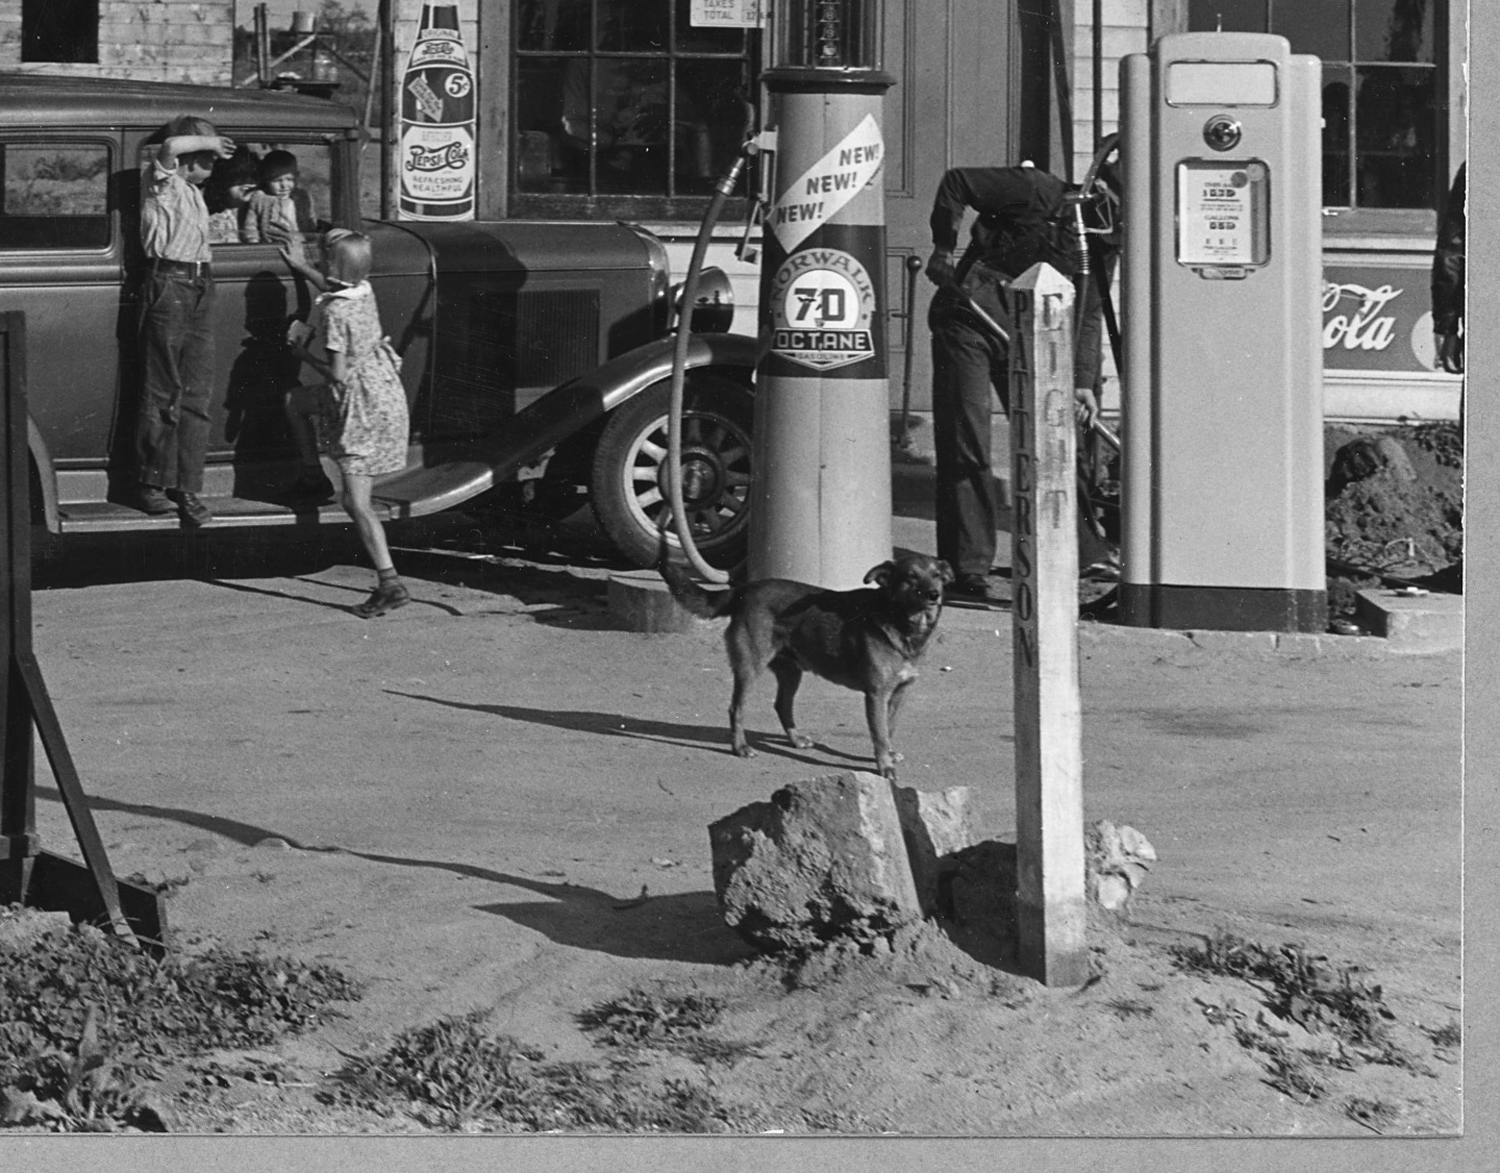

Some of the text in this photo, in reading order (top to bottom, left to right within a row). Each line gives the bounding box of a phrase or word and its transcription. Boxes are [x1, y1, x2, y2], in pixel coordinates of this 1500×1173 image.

[703, 10, 734, 20] TOTAL
[839, 143, 880, 166] NEW!
[806, 172, 858, 195] NEW!
[776, 201, 825, 225] NEW!
[771, 252, 872, 303] NORWALK
[1323, 282, 1404, 351] ola
[777, 332, 866, 349] OCTANE
[1041, 293, 1067, 529] EIGHT
[1013, 290, 1032, 667] PATTERSON
